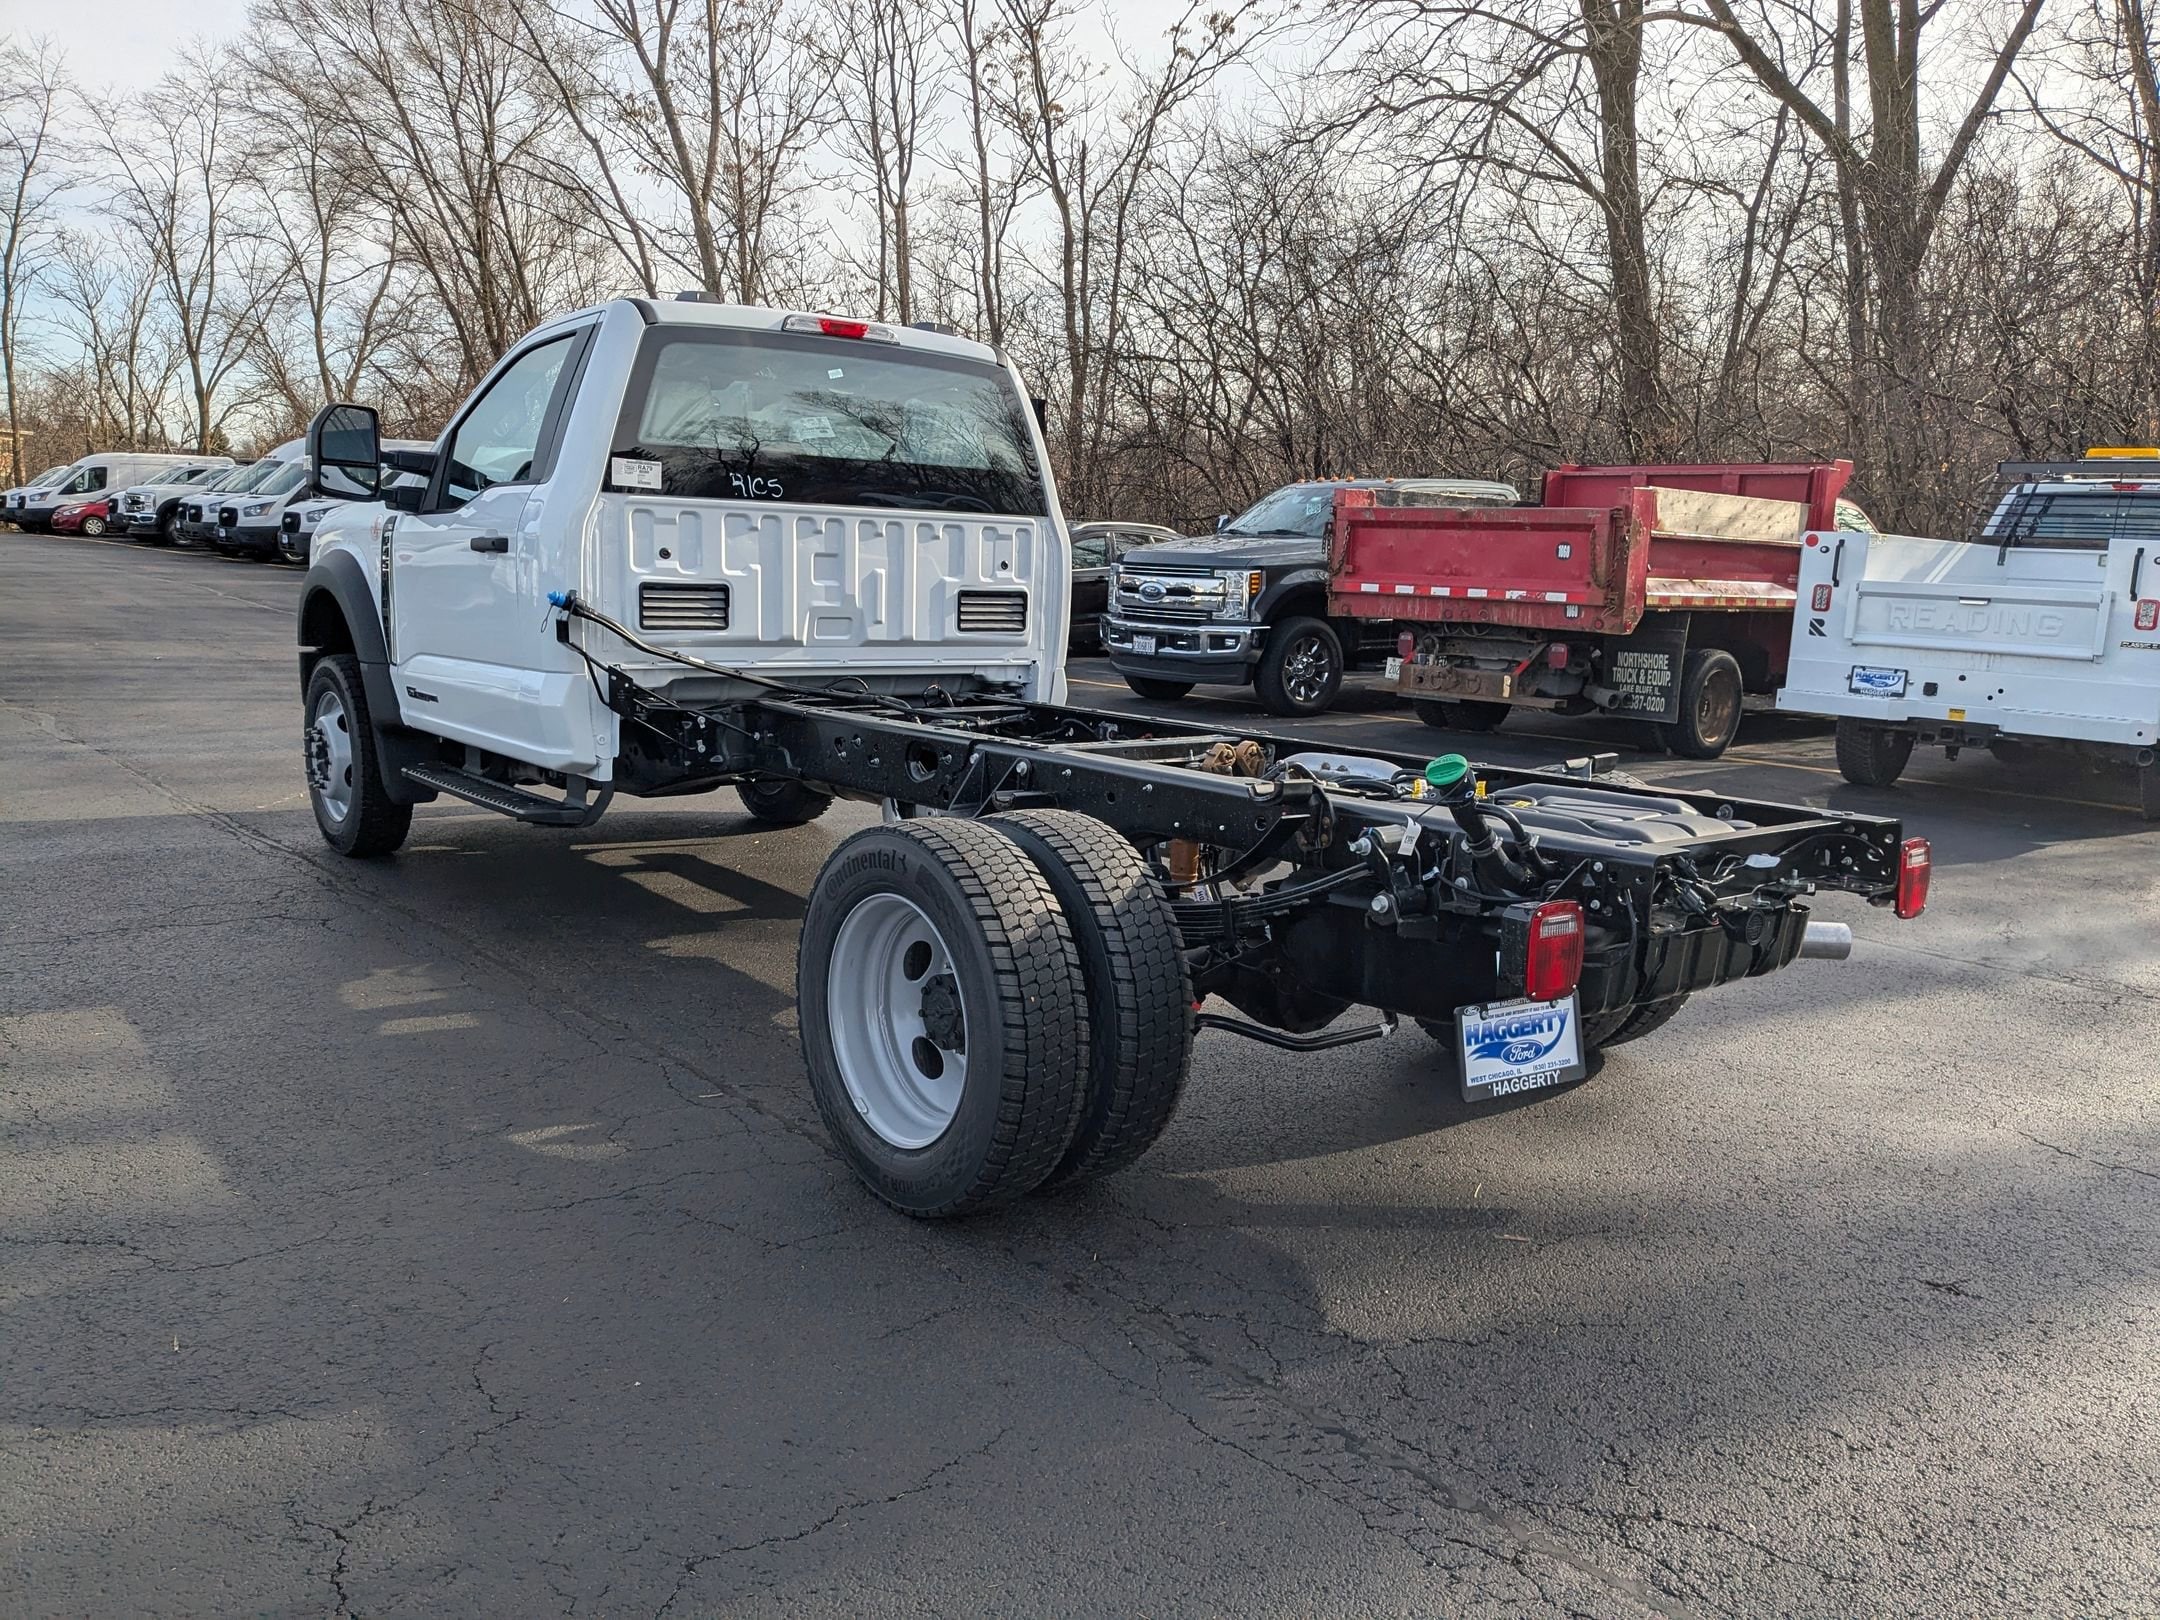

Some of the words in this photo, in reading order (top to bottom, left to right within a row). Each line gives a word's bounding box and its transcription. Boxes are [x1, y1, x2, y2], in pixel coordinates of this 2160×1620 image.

[1888, 601, 2064, 638] READING
[1617, 651, 1669, 670] NORTHSHORE
[1612, 667, 1638, 683] TRUCK
[1639, 669, 1645, 685] &
[1619, 684, 1634, 693] LAKE
[824, 848, 897, 899] Continental
[1465, 1008, 1570, 1048] HAGGERTY
[1509, 1043, 1536, 1062] Ford
[1470, 1076, 1486, 1084] WEST
[1493, 1069, 1560, 1096] HAGGERTY
